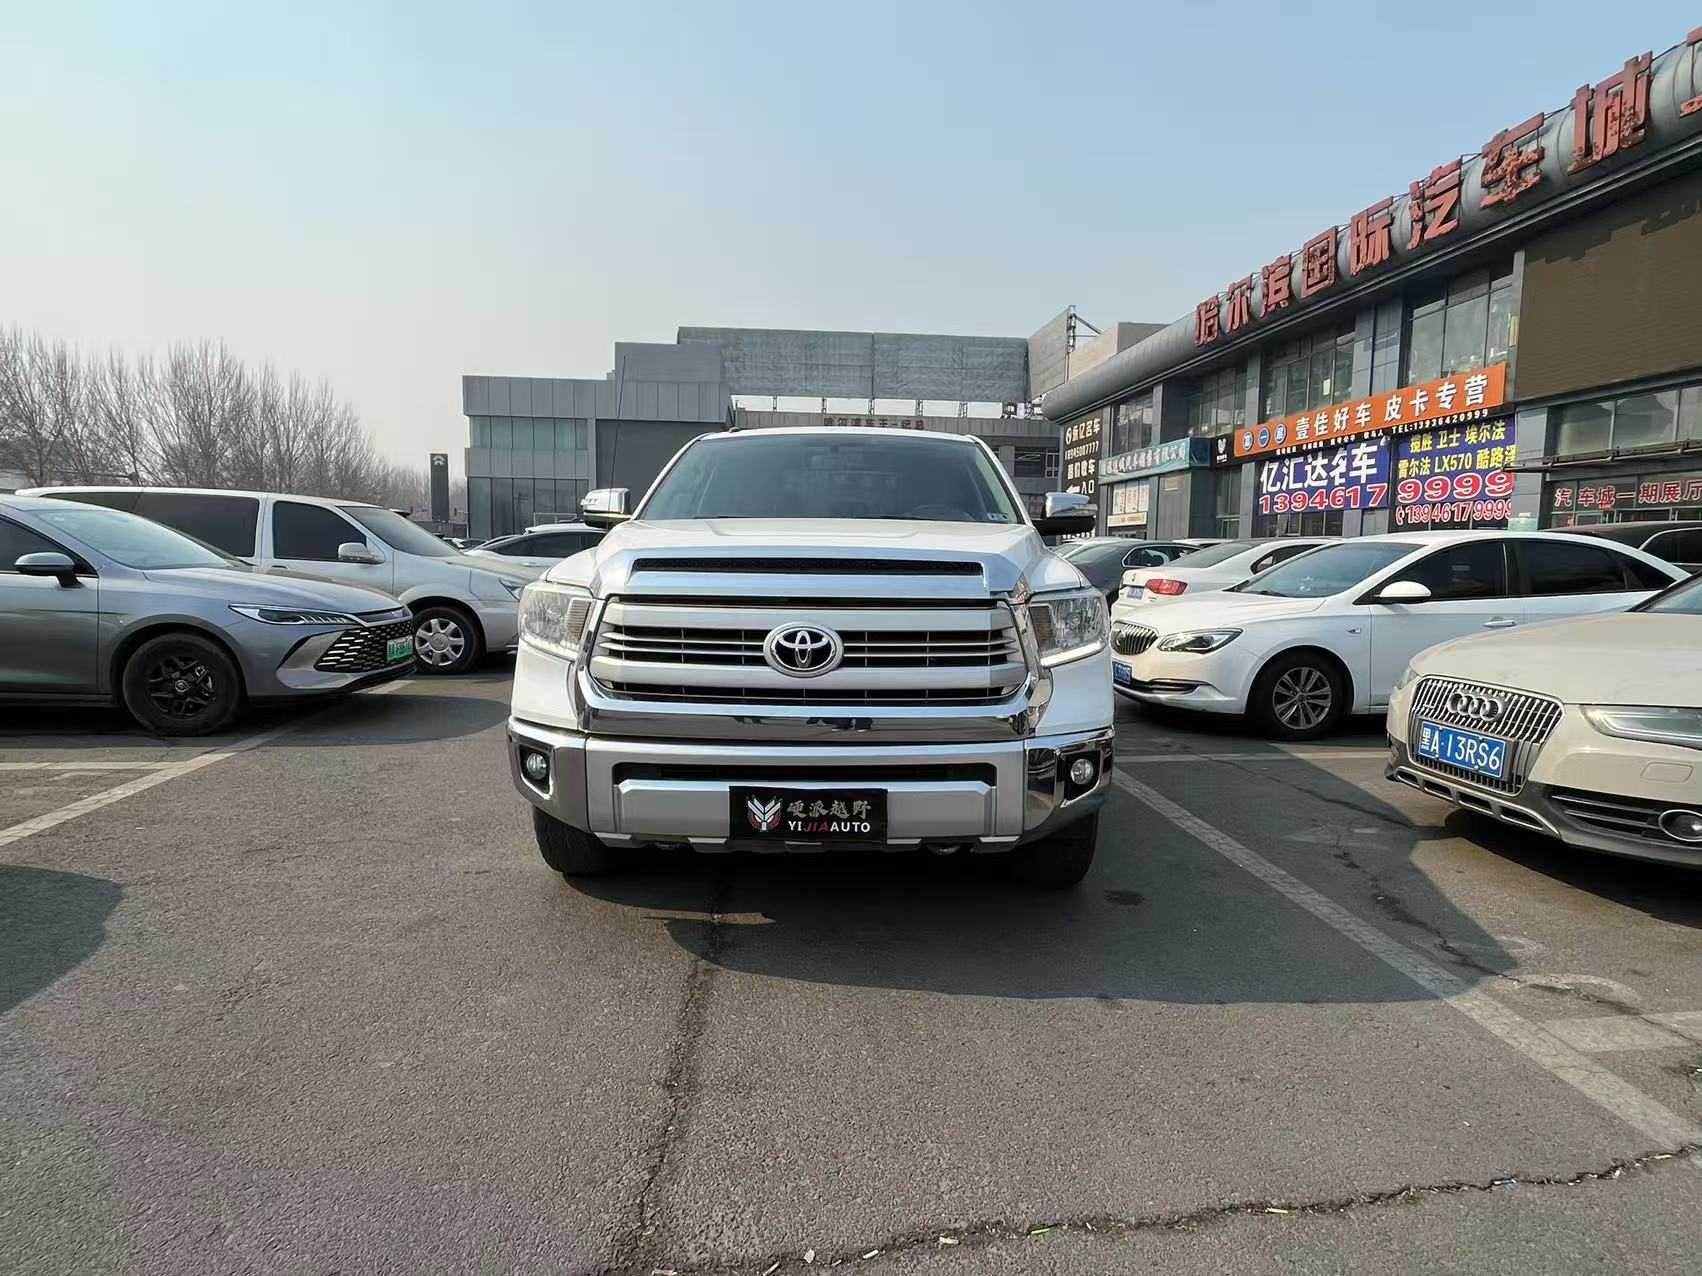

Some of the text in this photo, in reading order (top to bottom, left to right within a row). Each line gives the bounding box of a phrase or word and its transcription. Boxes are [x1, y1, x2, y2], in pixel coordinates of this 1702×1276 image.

[1195, 26, 1702, 347] 哈尔滨国际汽车城
[1295, 402, 1371, 440] 壹佳好车
[1384, 374, 1488, 421] 皮卡专营
[1437, 427, 1460, 449] 卫士
[1465, 419, 1506, 445] 埃尔法
[1260, 443, 1378, 493] 亿汇达名车
[1434, 452, 1472, 473] LX570
[1259, 483, 1388, 514] 1394617
[1397, 470, 1514, 503] 9999
[787, 800, 871, 819] 硬派越野
